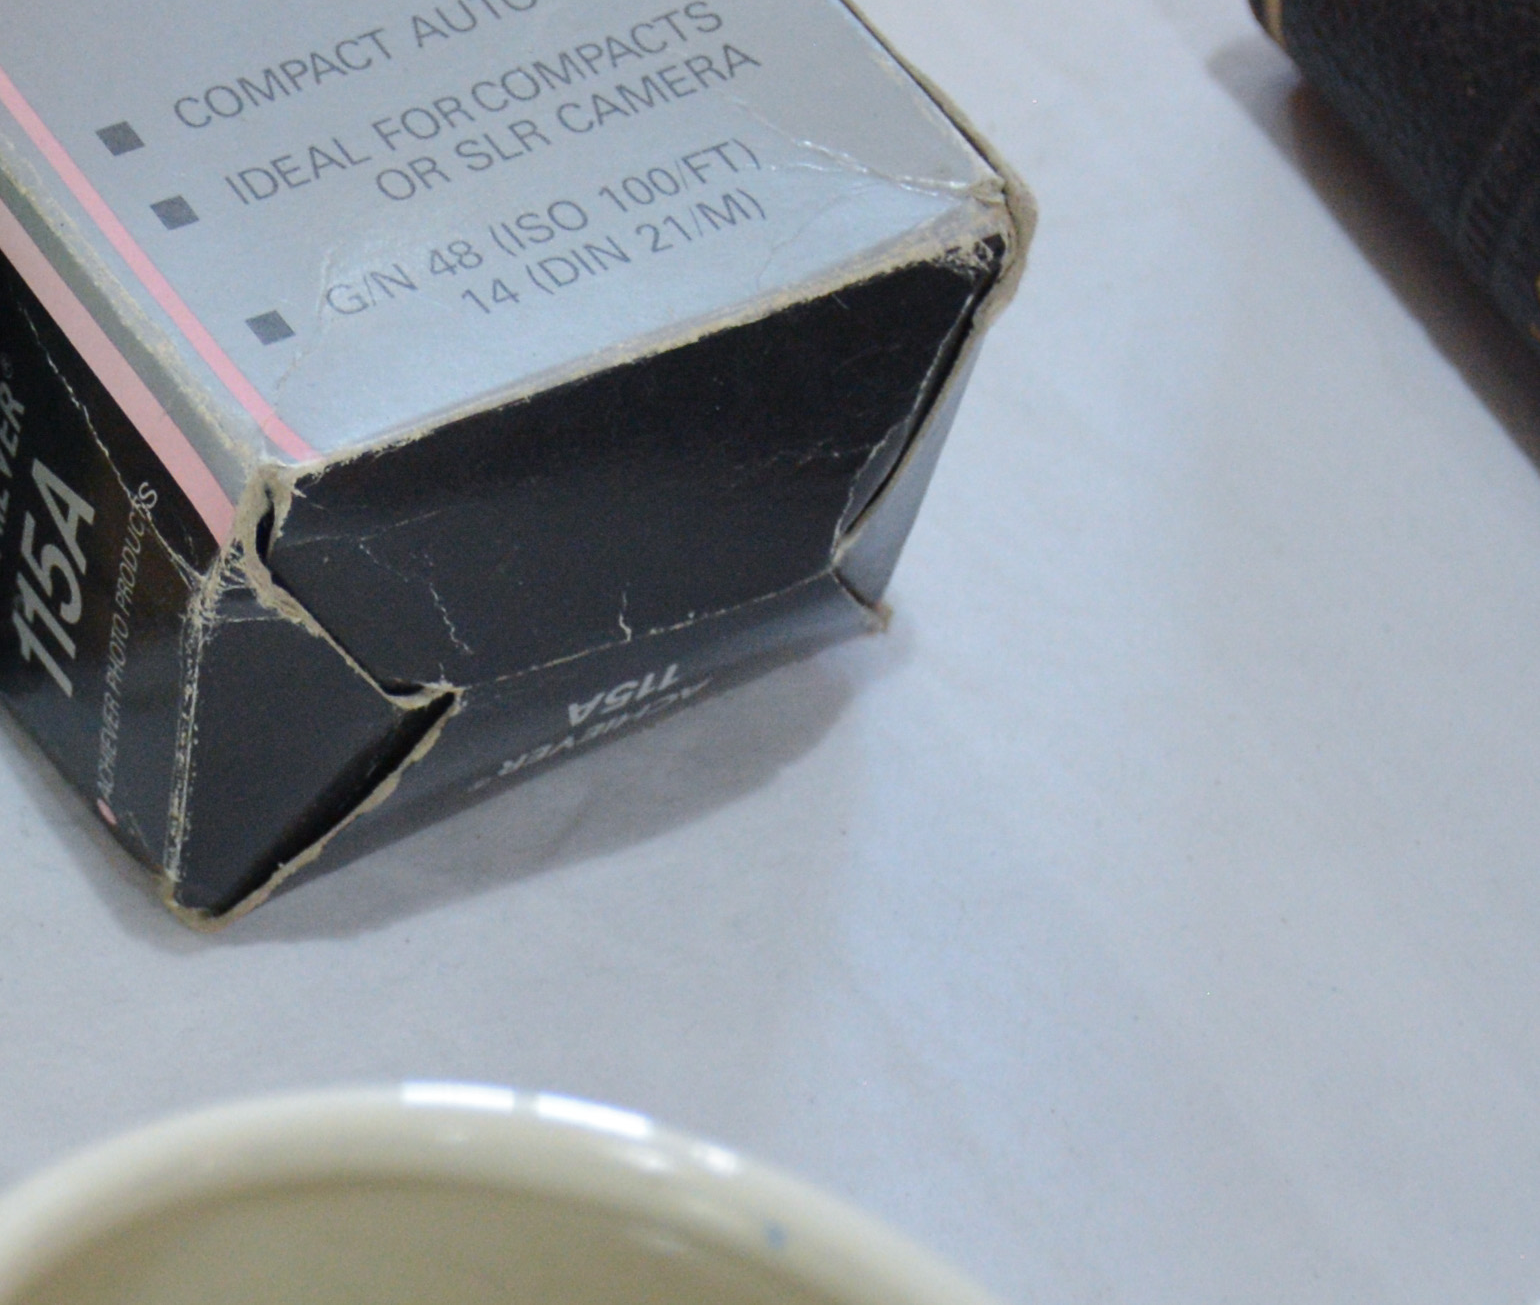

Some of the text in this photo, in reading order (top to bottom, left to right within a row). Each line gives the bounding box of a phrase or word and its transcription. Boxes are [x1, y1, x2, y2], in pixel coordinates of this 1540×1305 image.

[173, 28, 393, 131] COMPACT
[225, 0, 725, 206] IDEAL FOR COMPACTS
[375, 43, 761, 202] OR SLR CAMERA
[325, 138, 761, 317] G/N 48 (ISO 100/FT)
[461, 188, 766, 315] 14 (DIN 21/M)
[11, 458, 96, 696] 115A
[97, 481, 159, 804] ACHIEVER PHOTO PRODUCTS
[567, 663, 682, 726] 115A
